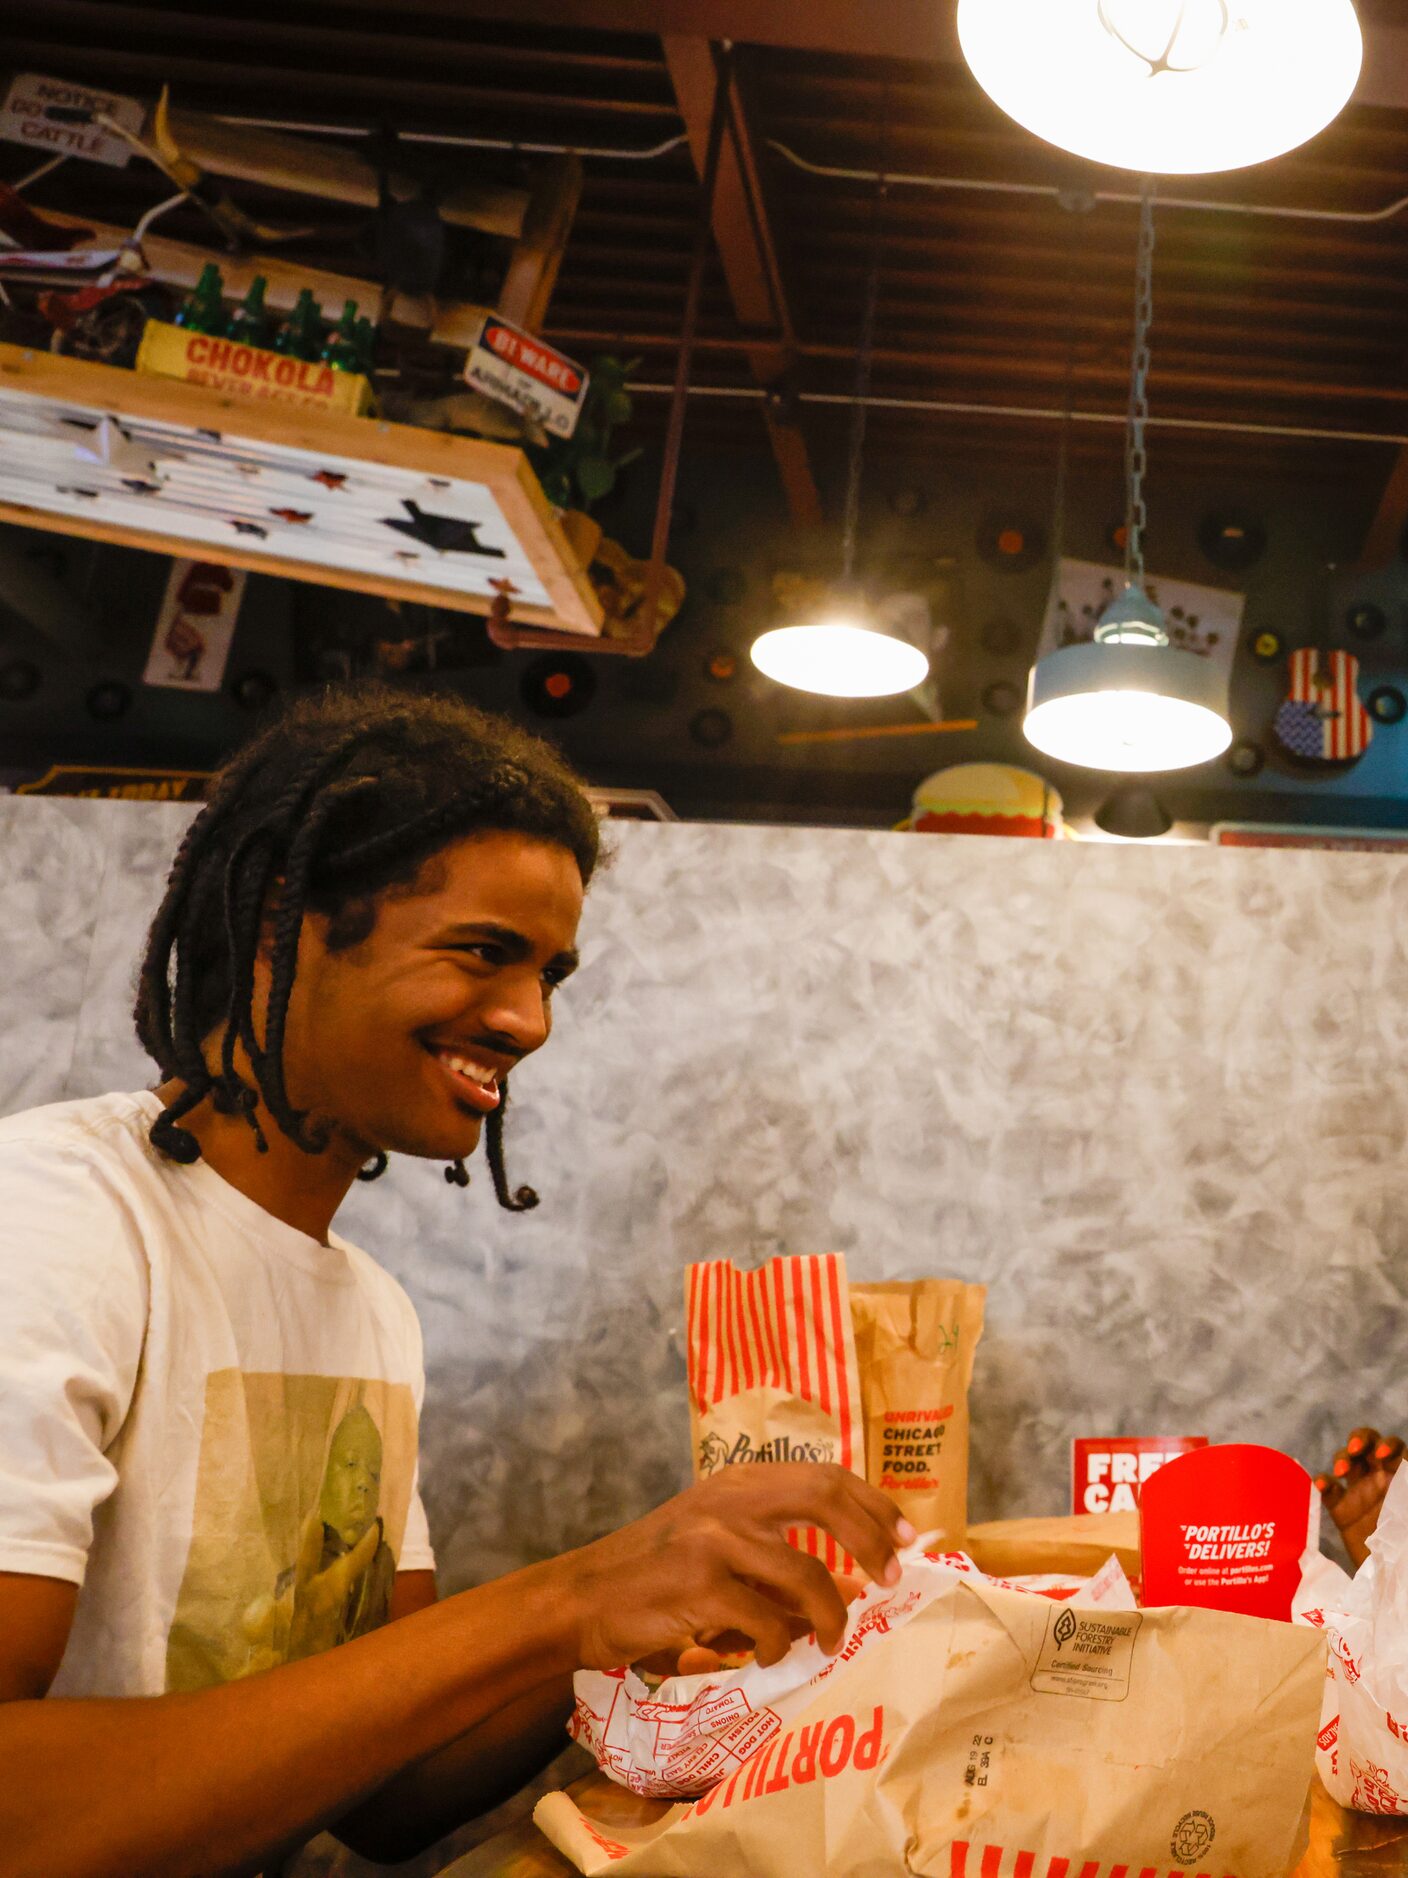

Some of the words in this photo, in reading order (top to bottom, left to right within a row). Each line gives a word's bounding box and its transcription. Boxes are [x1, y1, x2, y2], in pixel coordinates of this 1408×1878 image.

[186, 336, 335, 397] CHOKOLA
[883, 1443, 941, 1457] STREET
[882, 1461, 930, 1474] FOOD.
[1087, 1452, 1184, 1484] FRE
[1184, 1522, 1276, 1542] PORTILLO'S
[1188, 1540, 1271, 1560] DELIVERS!
[1178, 1566, 1198, 1575] Order
[1199, 1566, 1220, 1575] online
[1208, 1578, 1220, 1586] the
[1221, 1577, 1252, 1586] Portillo's
[1079, 1621, 1133, 1637] SUSTAINABLE
[1076, 1631, 1115, 1646] FORESTRY
[1072, 1642, 1112, 1656] INITIATIVE
[1051, 1660, 1081, 1672] Certified
[1082, 1663, 1113, 1677] Sourcing
[705, 1696, 735, 1715] TOMATO
[710, 1712, 740, 1729] ONIONS
[727, 1711, 760, 1742] POLISH
[757, 1717, 775, 1737] HOT
[738, 1736, 758, 1756] DOG
[972, 1734, 983, 1747] 22
[984, 1736, 994, 1745] C
[969, 1750, 978, 1760] 19
[696, 1752, 720, 1775] CHILI
[676, 1774, 697, 1785] DOG
